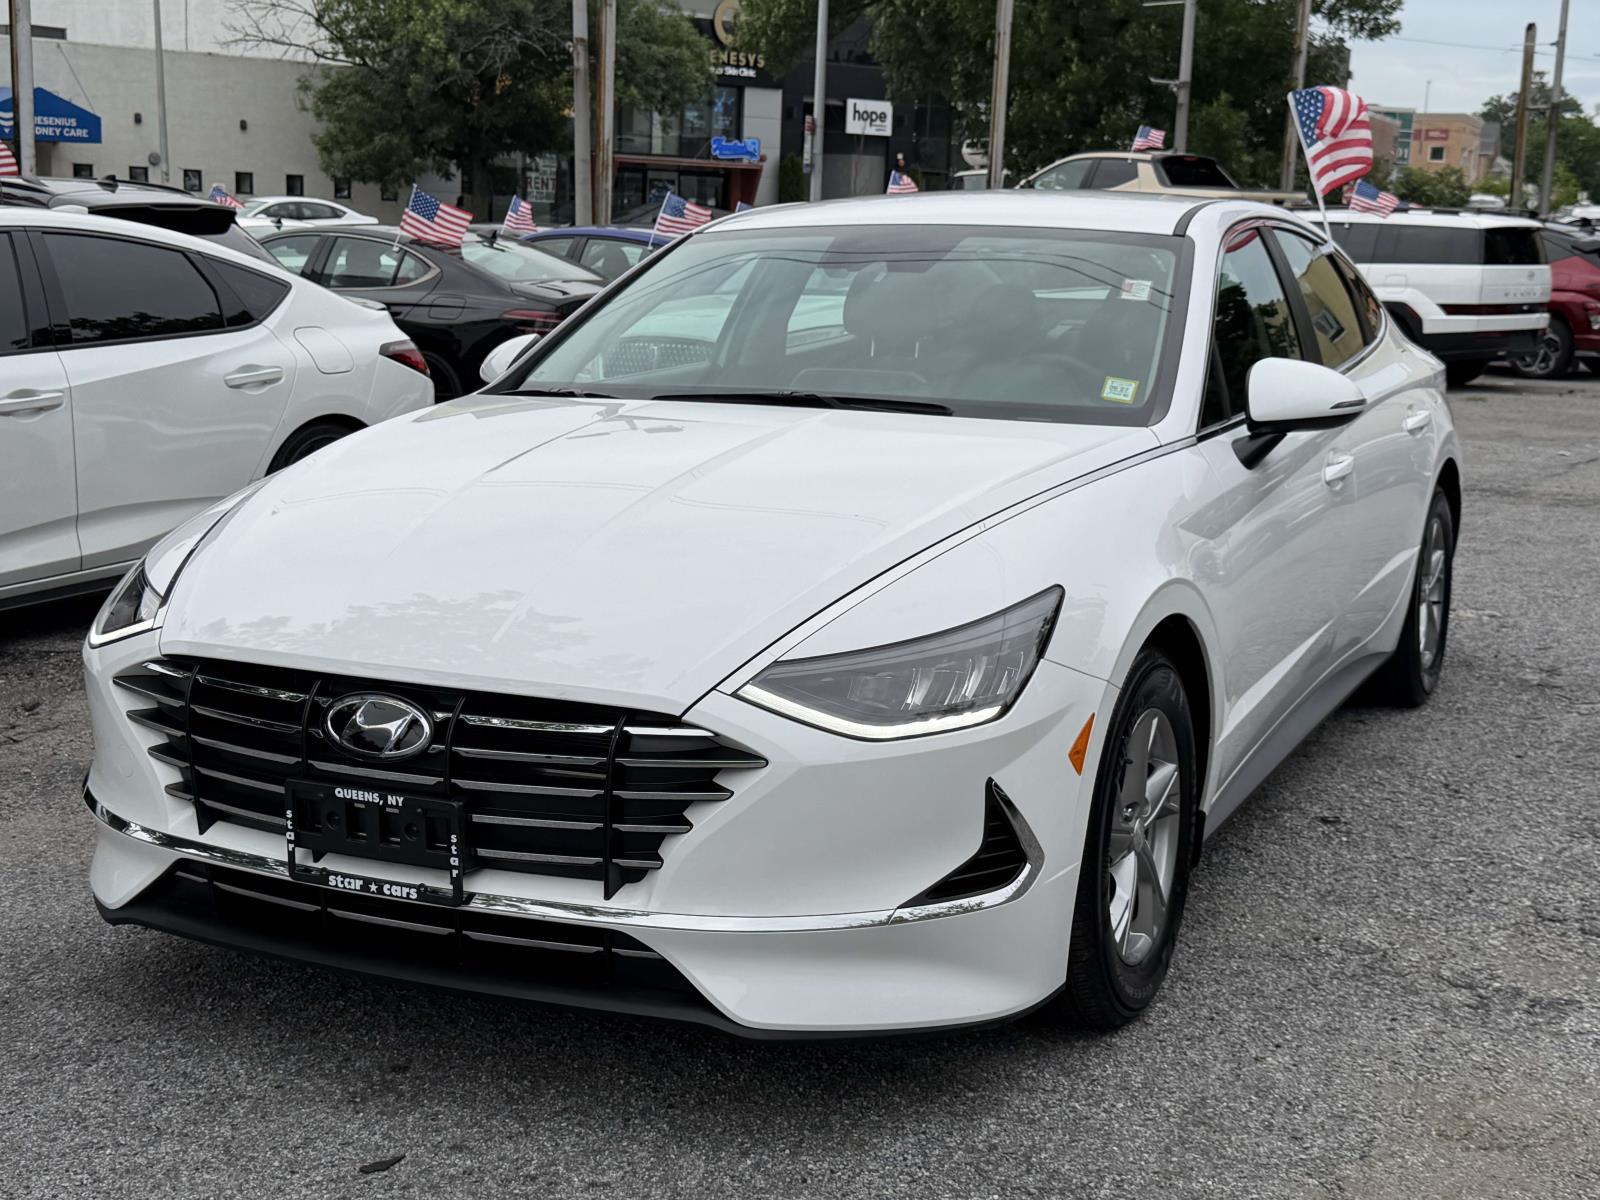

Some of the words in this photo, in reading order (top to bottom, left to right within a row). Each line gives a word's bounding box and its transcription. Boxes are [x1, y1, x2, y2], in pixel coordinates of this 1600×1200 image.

[709, 49, 766, 69] ENESYS
[34, 115, 77, 127] ESENIUS
[853, 102, 887, 128] hope
[35, 126, 61, 137] DNEY
[63, 128, 89, 138] CARE
[335, 787, 383, 806] QUEENS,
[387, 795, 404, 807] NY
[286, 809, 295, 851] star
[450, 834, 459, 878] star
[328, 874, 363, 891] star
[383, 883, 418, 899] cars
